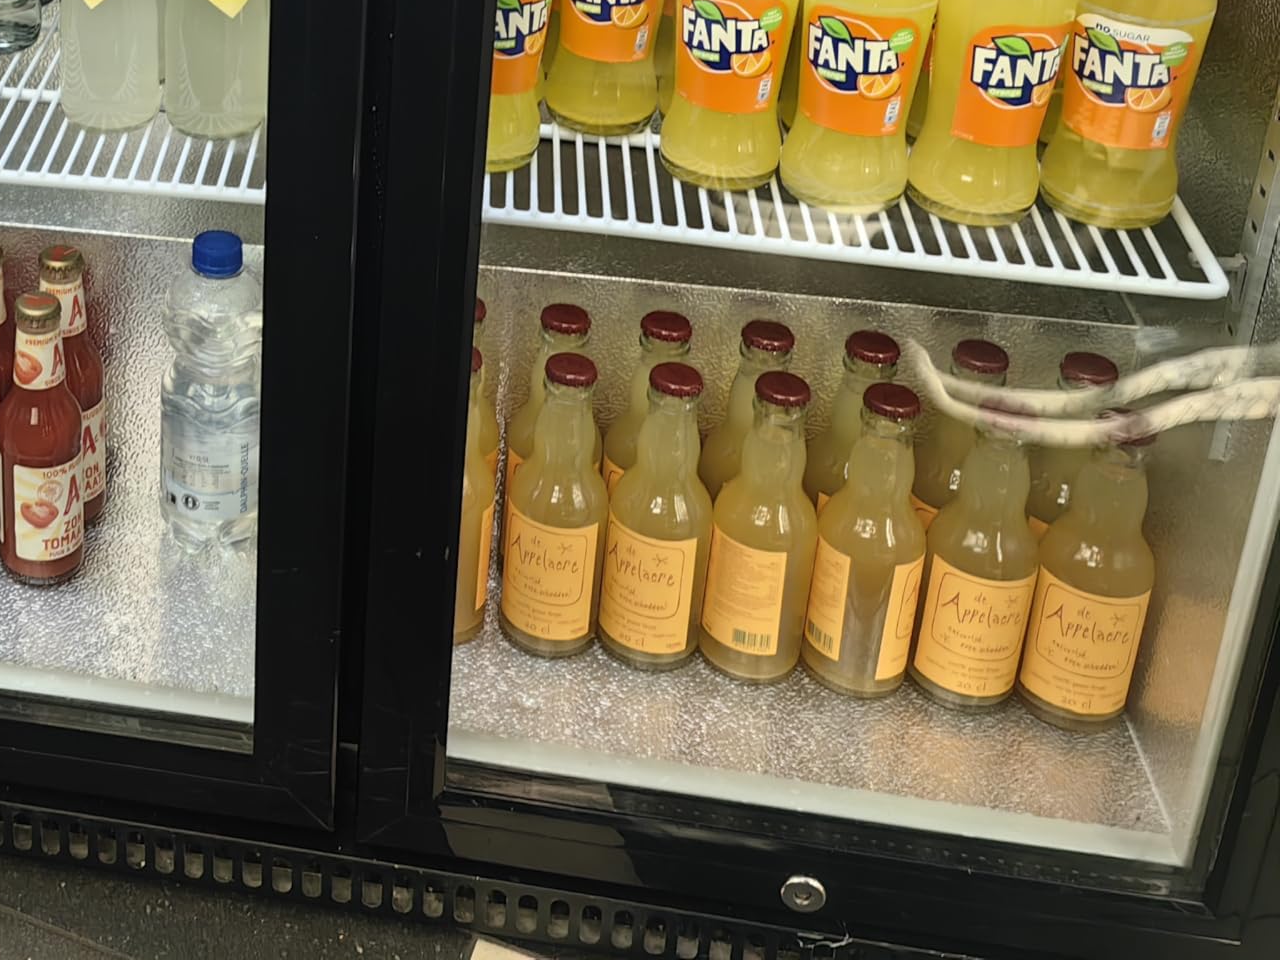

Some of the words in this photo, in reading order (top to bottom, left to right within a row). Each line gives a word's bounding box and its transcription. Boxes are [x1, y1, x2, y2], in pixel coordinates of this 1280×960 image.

[495, 0, 548, 39] ANTA
[683, 6, 769, 53] FANTA
[1096, 22, 1111, 35] no
[1112, 28, 1152, 42] SUGAR
[808, 23, 898, 74] FANTA
[1074, 34, 1170, 88] FANTA
[42, 468, 67, 479] 100%
[42, 527, 82, 552] TOMAA
